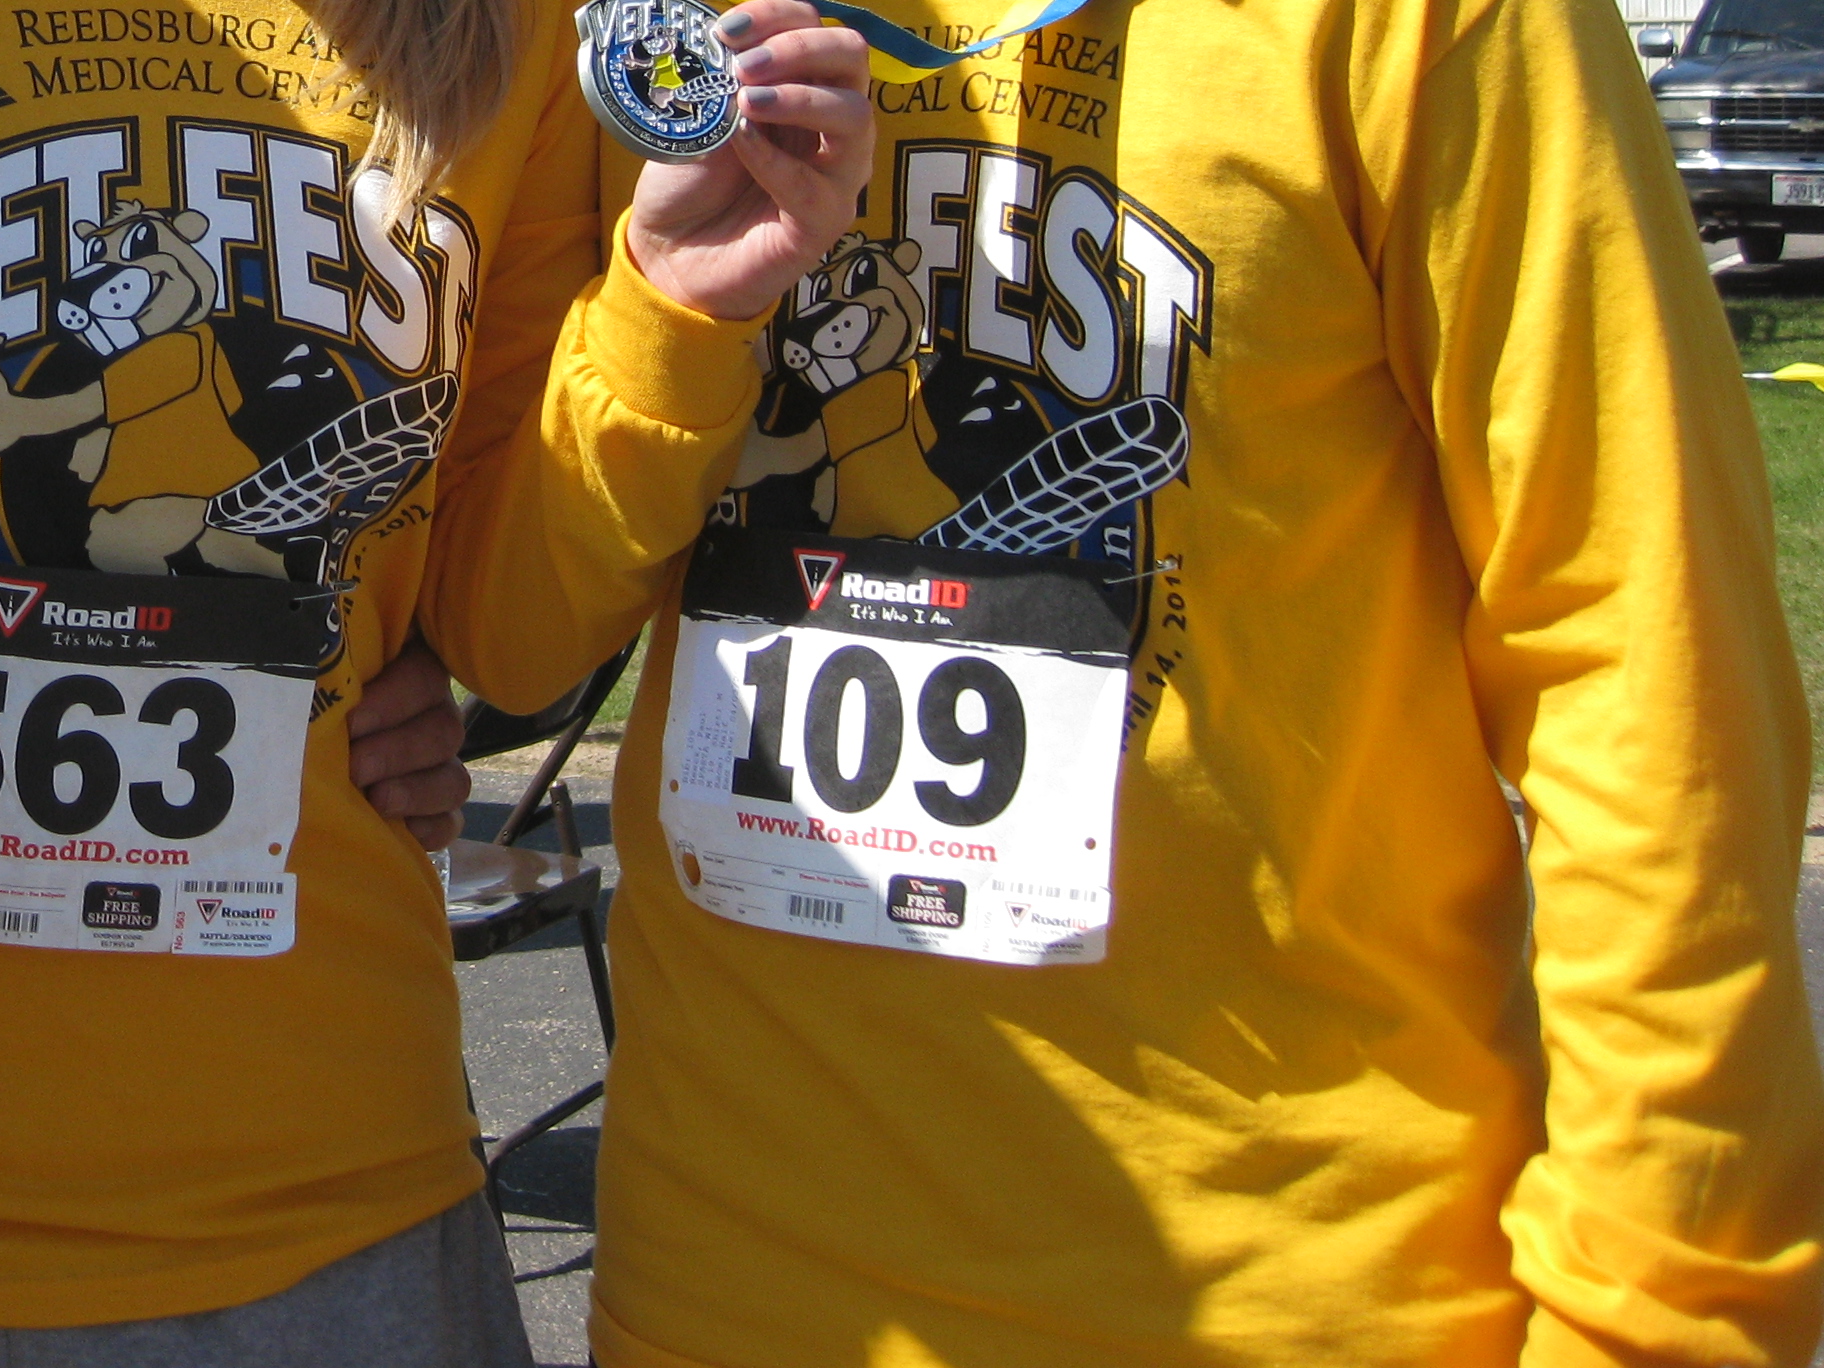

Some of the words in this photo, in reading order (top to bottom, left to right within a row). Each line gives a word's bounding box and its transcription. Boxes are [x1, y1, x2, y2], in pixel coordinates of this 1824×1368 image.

[12, 8, 276, 52] REEDSBURG
[1013, 30, 1120, 81] AREA
[23, 56, 224, 98] MEDICAL
[235, 60, 381, 126] CENTE
[960, 71, 1108, 138] CENTER
[170, 118, 479, 378] FEST
[897, 142, 1212, 404] FEST
[840, 571, 970, 609] RoadID
[1162, 553, 1186, 632] 2012
[40, 600, 174, 632] RoadID
[849, 602, 877, 622] It's
[882, 607, 909, 625] Who
[914, 608, 927, 625] I
[52, 631, 80, 647] It's
[86, 633, 114, 648] Who
[121, 633, 131, 648] I
[731, 635, 1027, 828] 109
[737, 810, 998, 863] www.RoadID.com
[87, 913, 153, 927] SHIPPING
[103, 900, 141, 914] FREE
[221, 907, 278, 919] RoadID
[891, 905, 959, 925] SHIPPING
[906, 893, 946, 911] FREE
